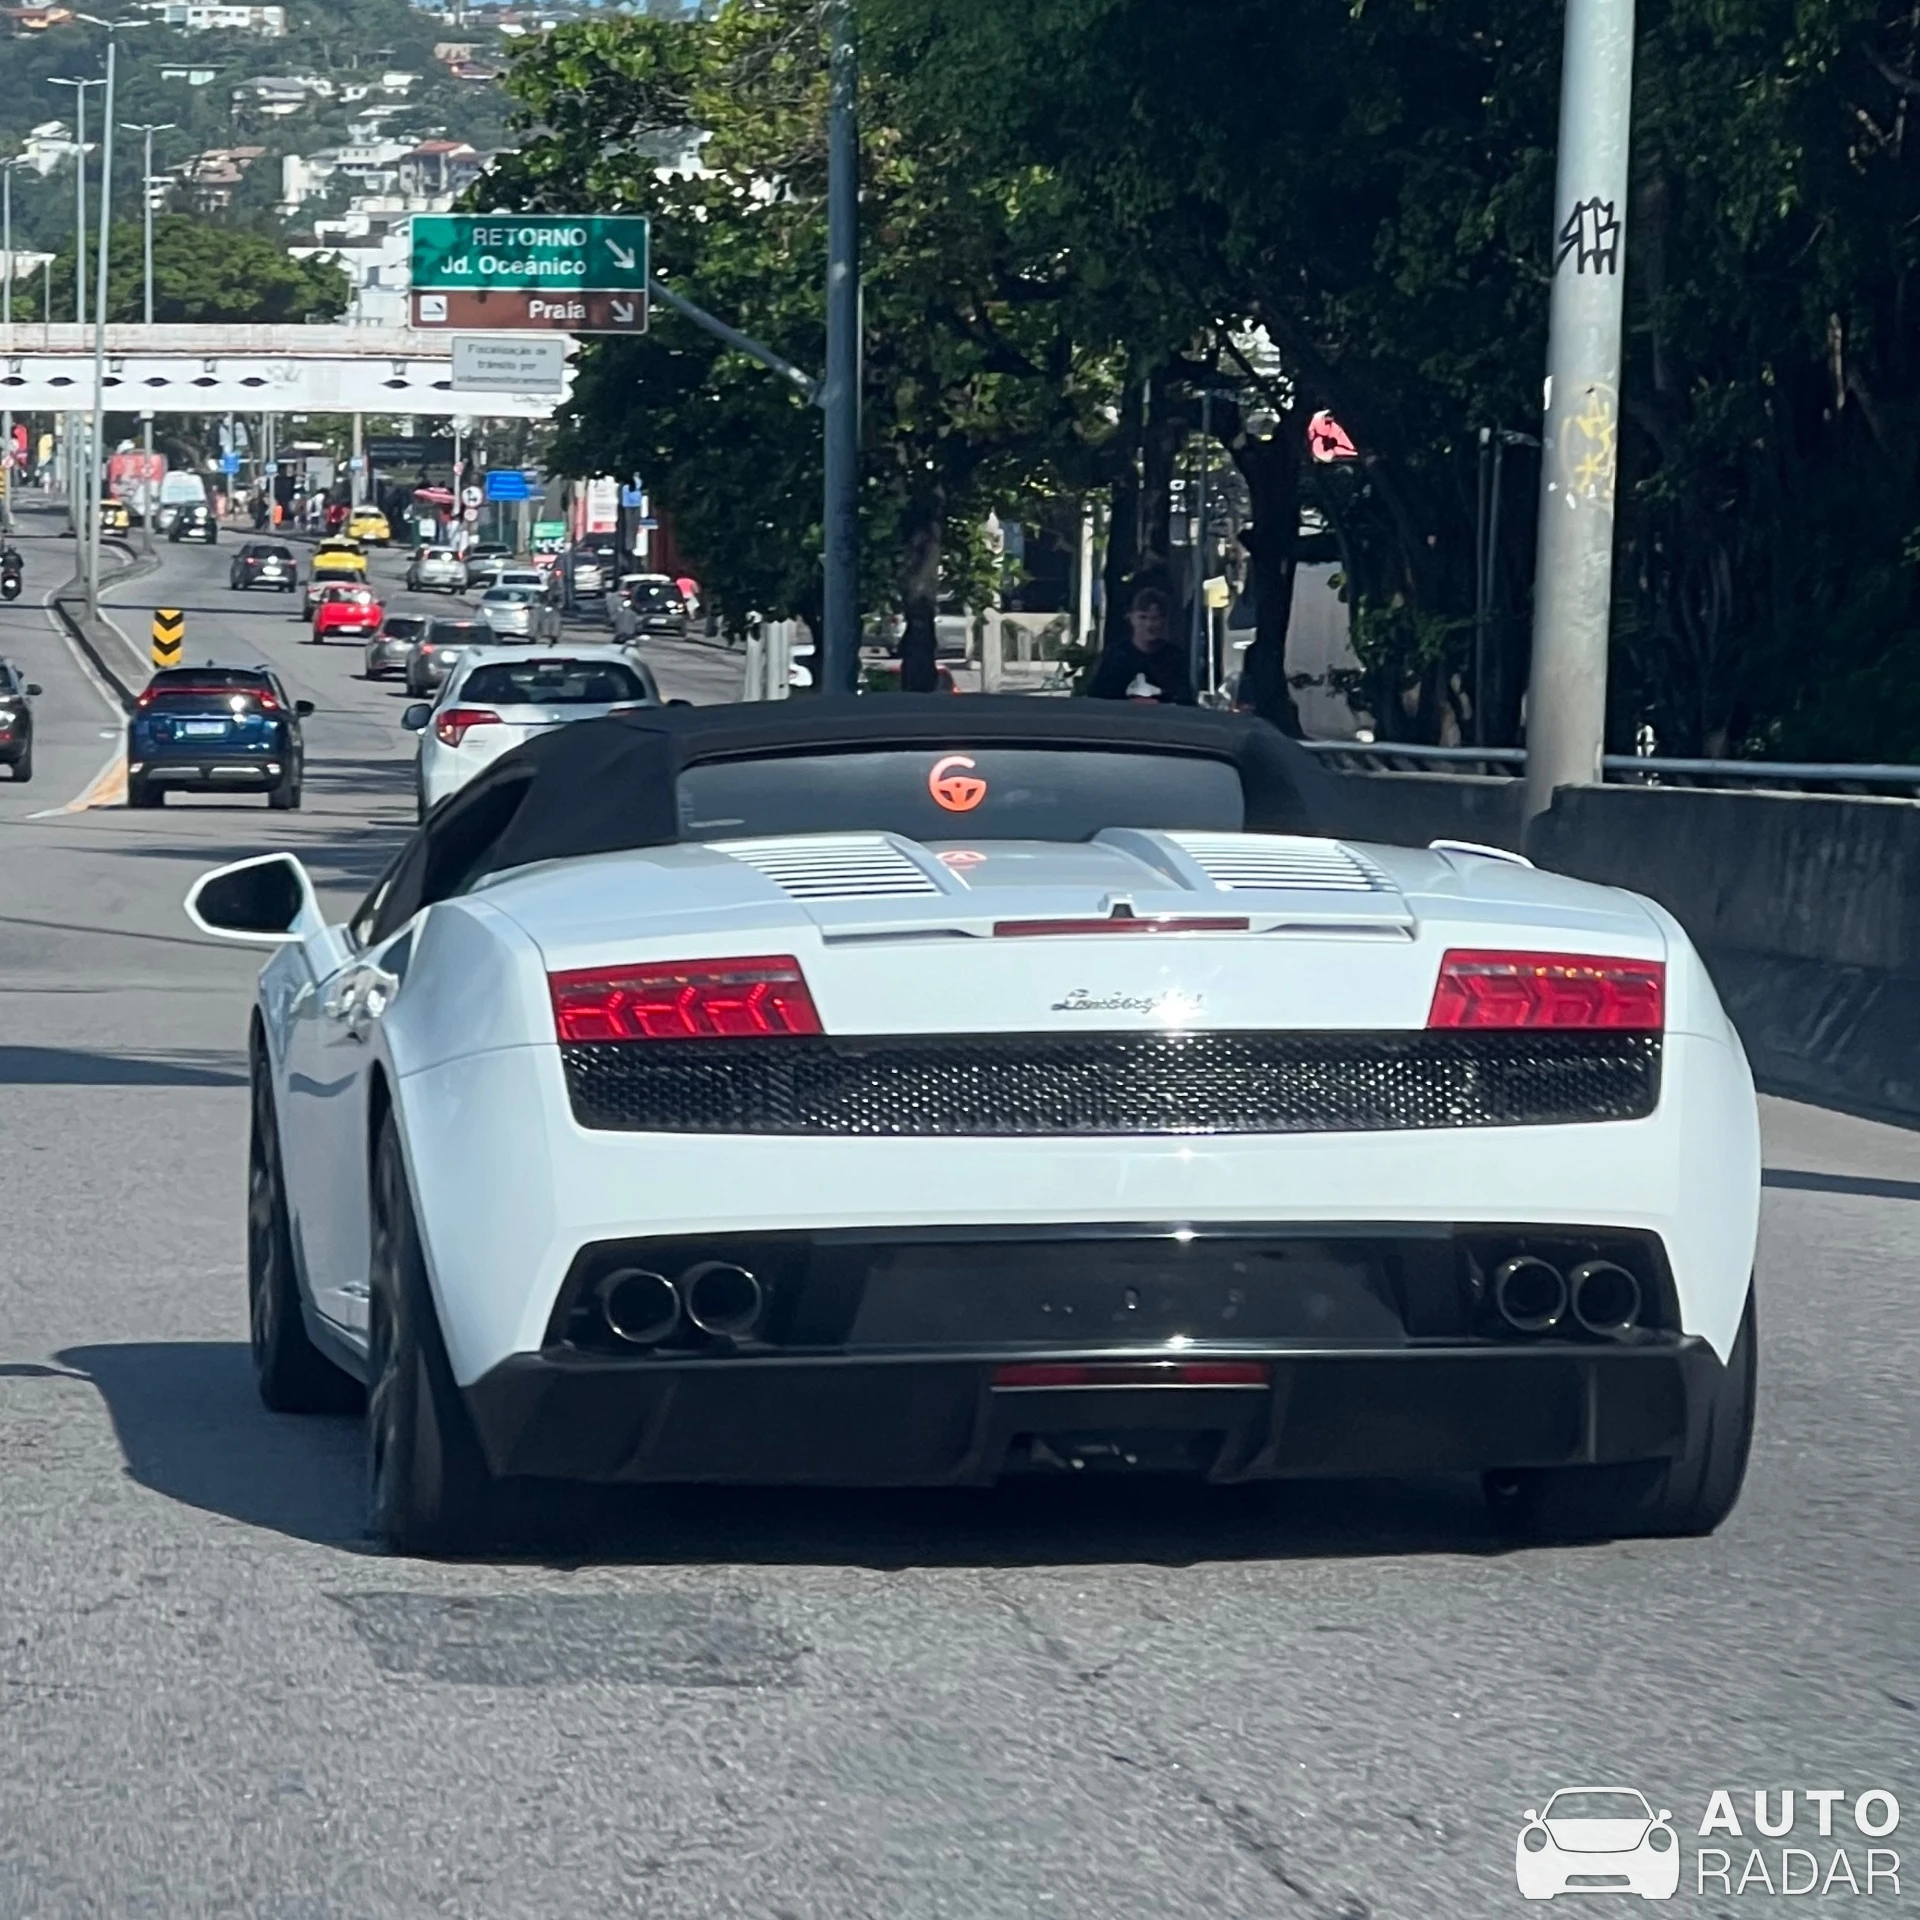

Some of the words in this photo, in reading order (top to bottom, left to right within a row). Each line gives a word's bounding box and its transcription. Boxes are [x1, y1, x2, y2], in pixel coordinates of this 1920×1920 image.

[472, 227, 587, 247] RETORNO
[440, 255, 473, 275] Jd.
[478, 254, 587, 275] Oceânico
[529, 299, 586, 320] Praia
